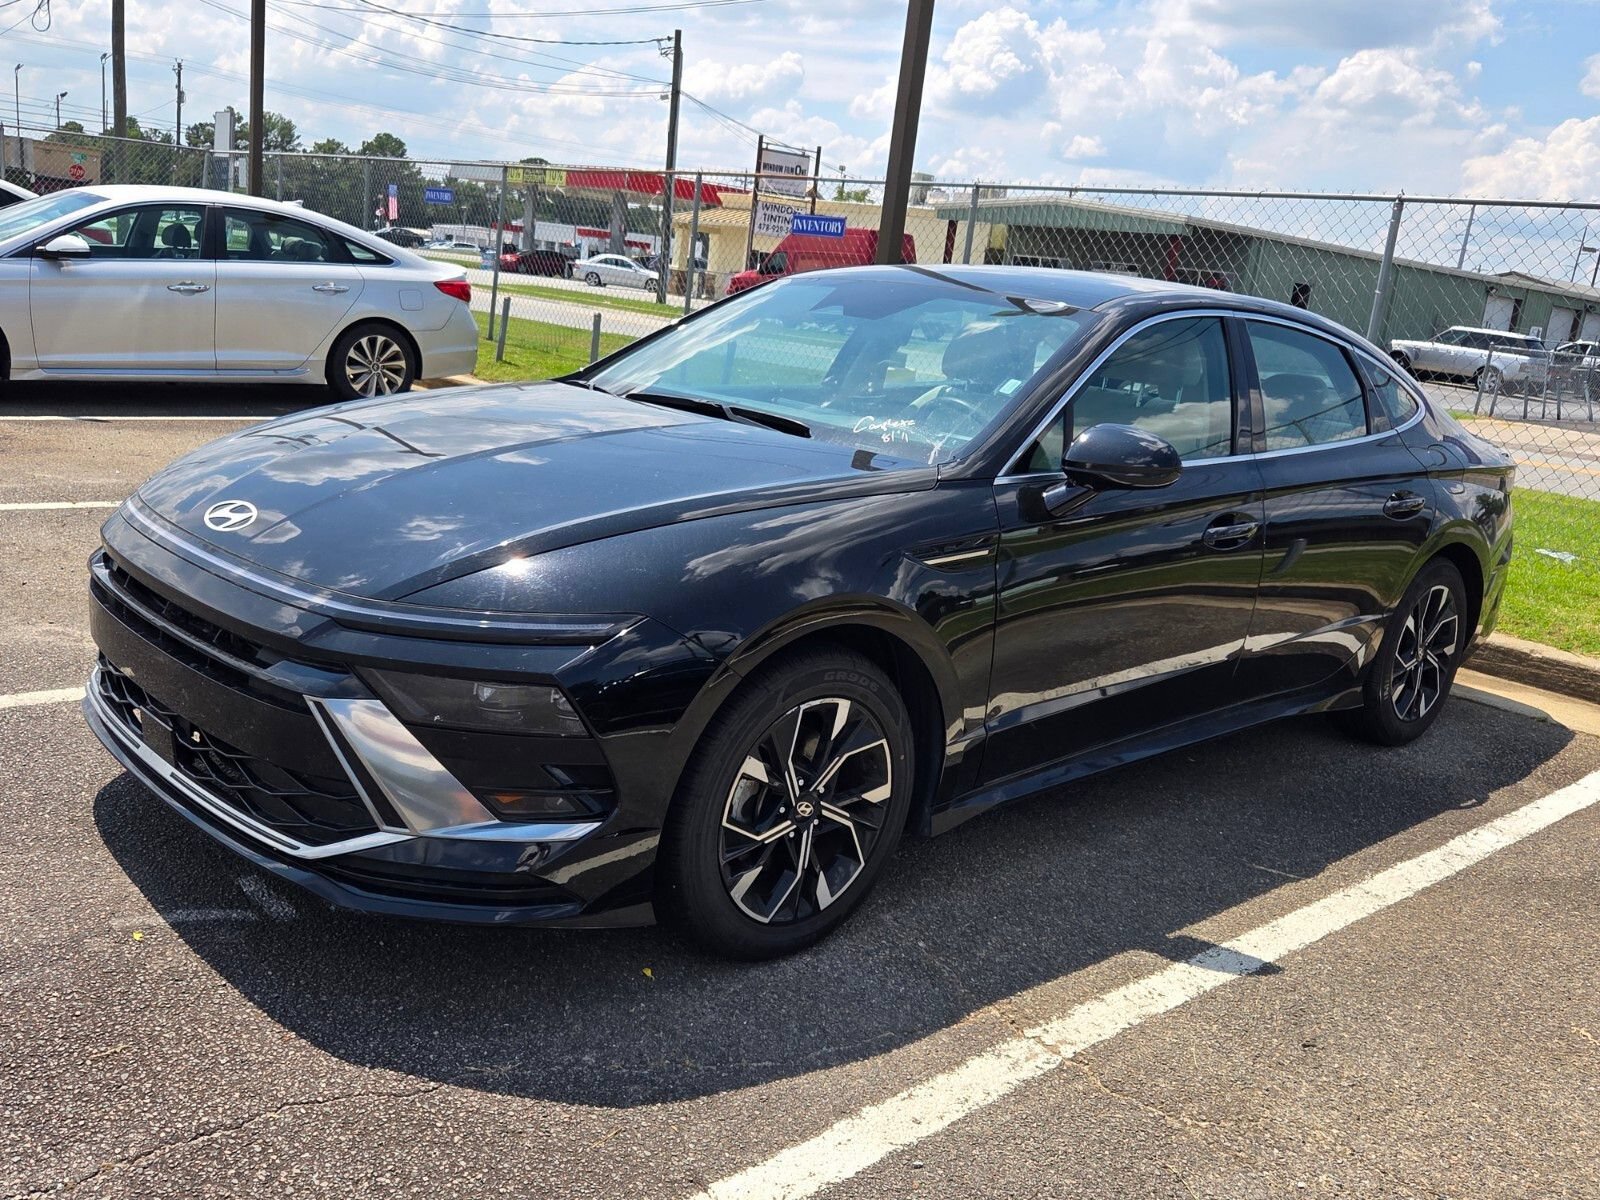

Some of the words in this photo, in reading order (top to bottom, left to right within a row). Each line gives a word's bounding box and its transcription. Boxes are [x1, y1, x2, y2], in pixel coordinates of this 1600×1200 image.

[762, 163, 784, 173] WINDOW
[763, 212, 792, 225] TINTIN
[793, 218, 844, 234] INVENTORY
